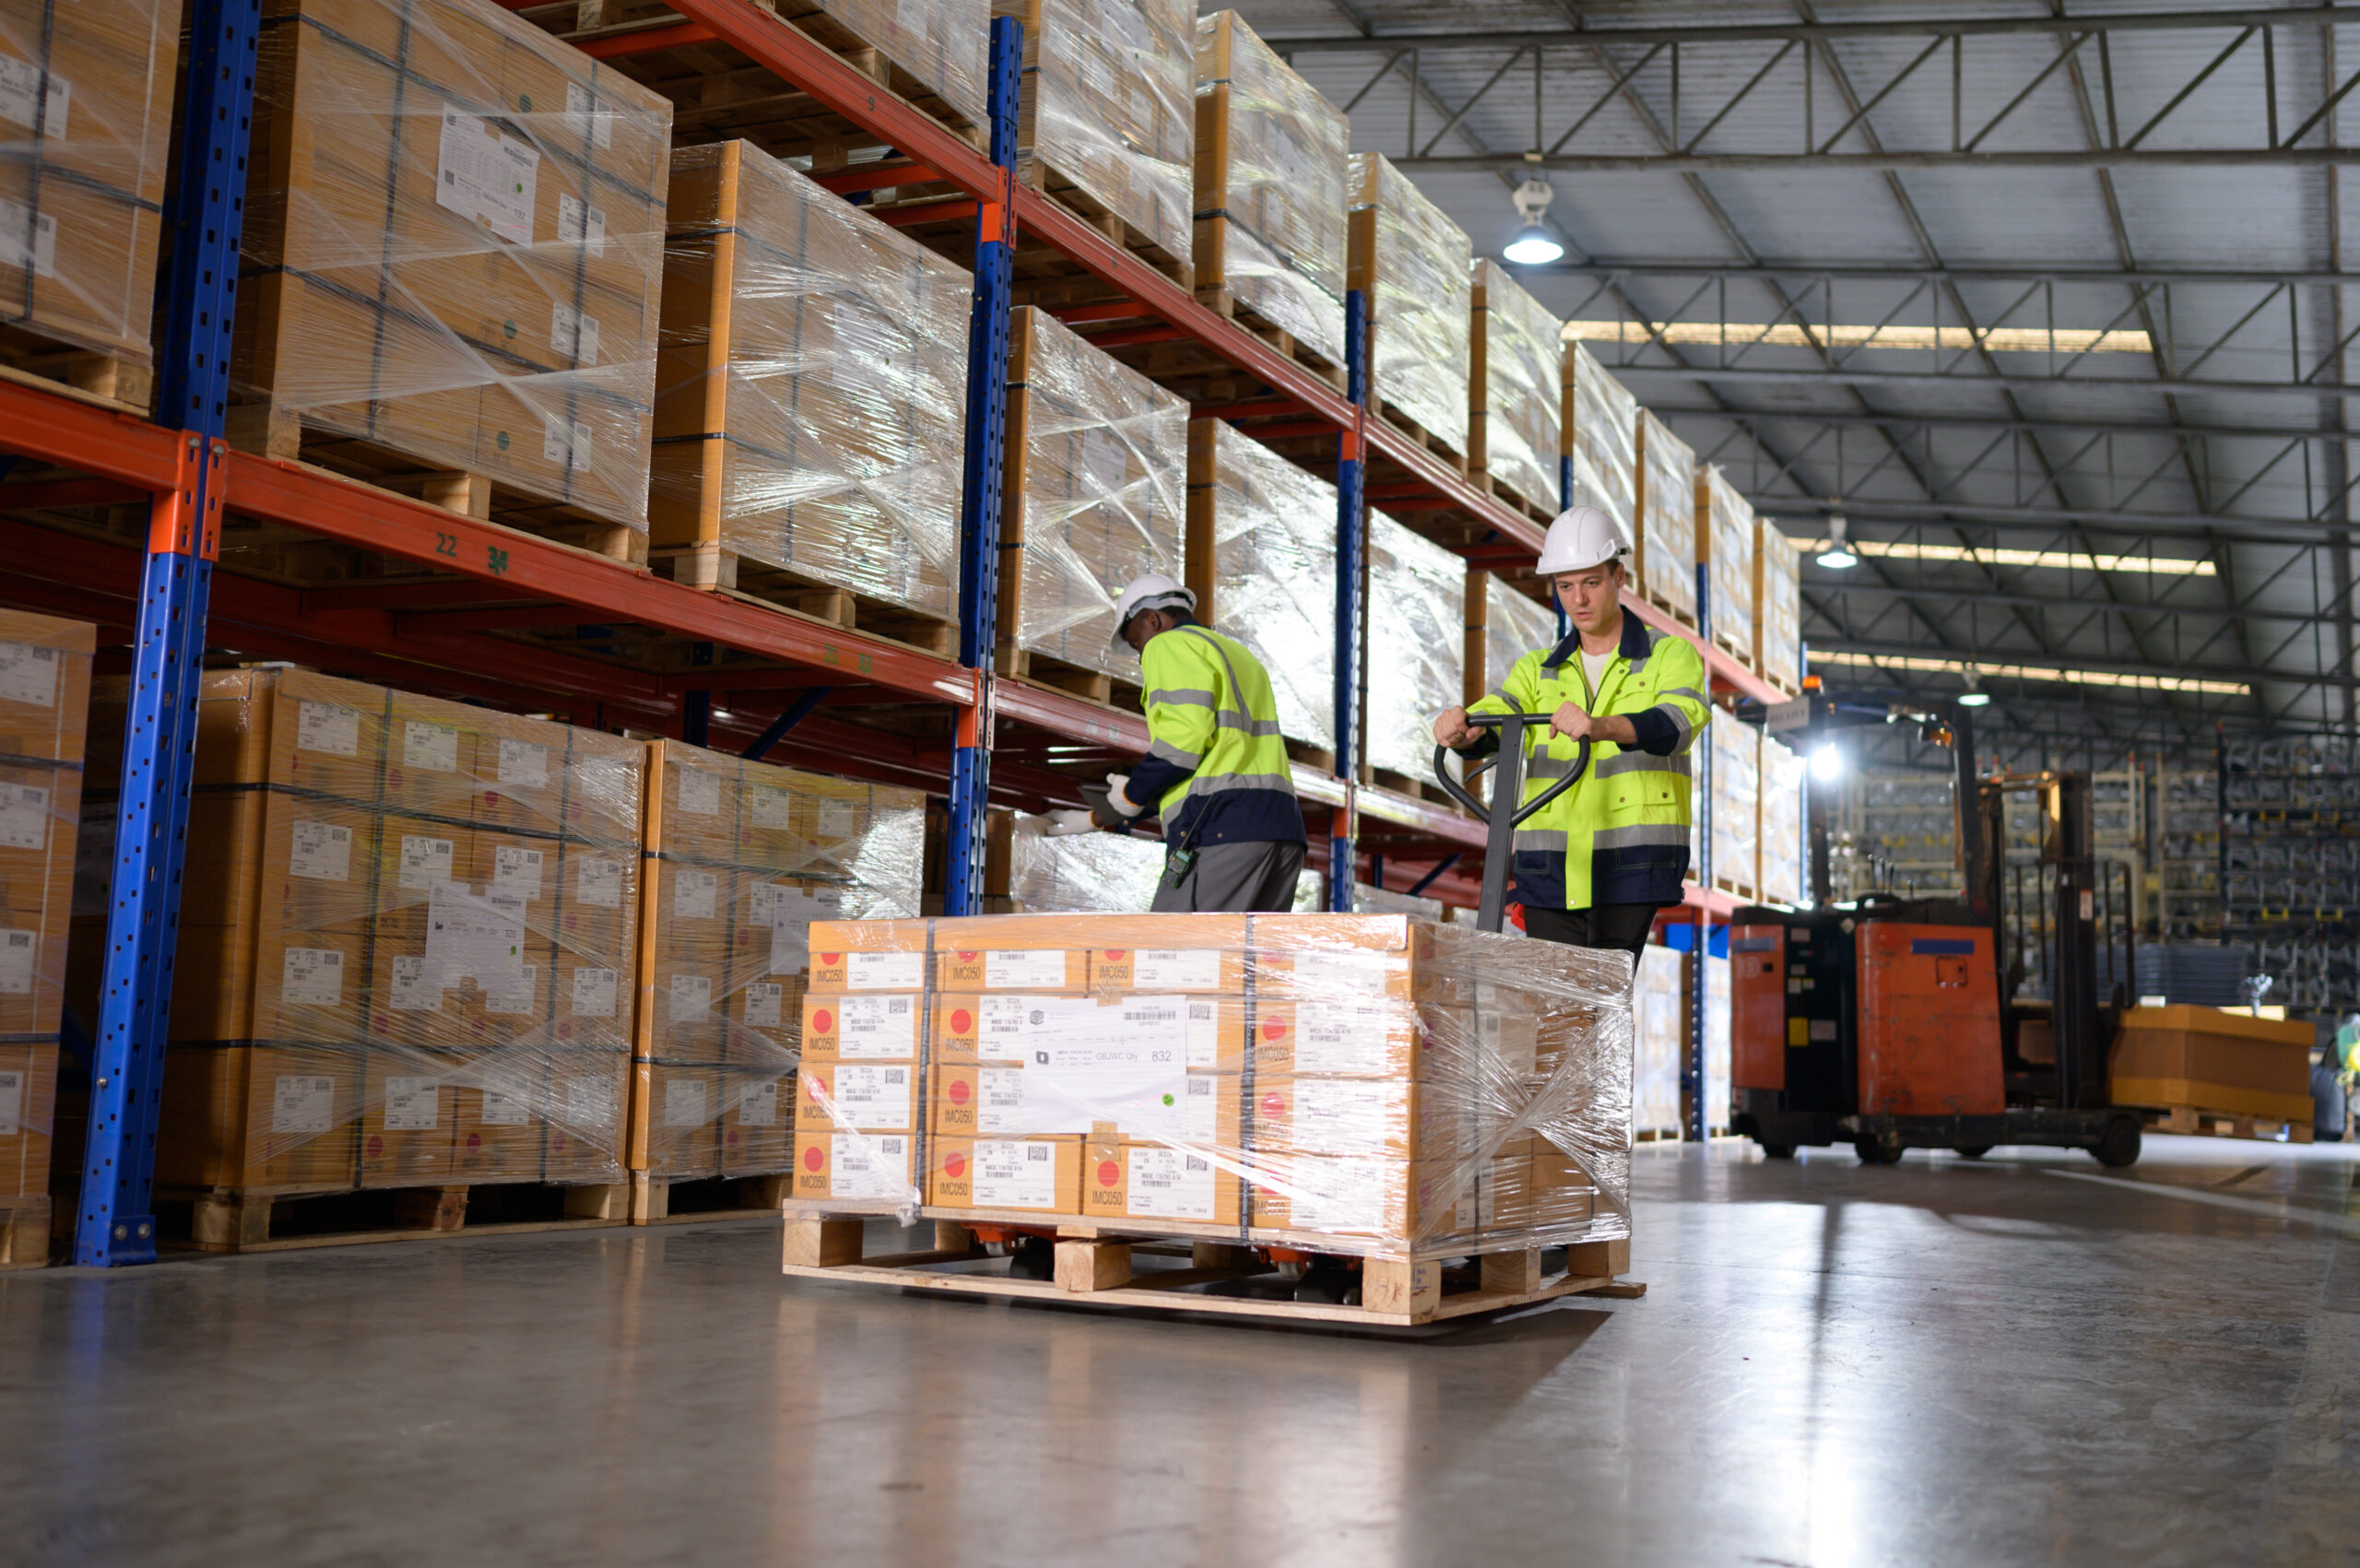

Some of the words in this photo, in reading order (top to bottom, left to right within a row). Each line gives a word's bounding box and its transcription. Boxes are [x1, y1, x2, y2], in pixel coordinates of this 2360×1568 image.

[436, 531, 457, 558] 22
[504, 928, 516, 938] 320
[817, 969, 844, 983] IMC050
[952, 966, 981, 980] IMC050
[1099, 965, 1129, 979] IMC050
[808, 1037, 835, 1051] IMC050
[945, 1038, 974, 1052] IMC050
[1126, 1051, 1139, 1062] Qty
[1151, 1050, 1172, 1062] 832
[944, 1109, 973, 1124] IMC050
[800, 1175, 827, 1189] IMC050
[939, 1182, 968, 1196] IMC050
[1092, 1190, 1123, 1206] IMC050
